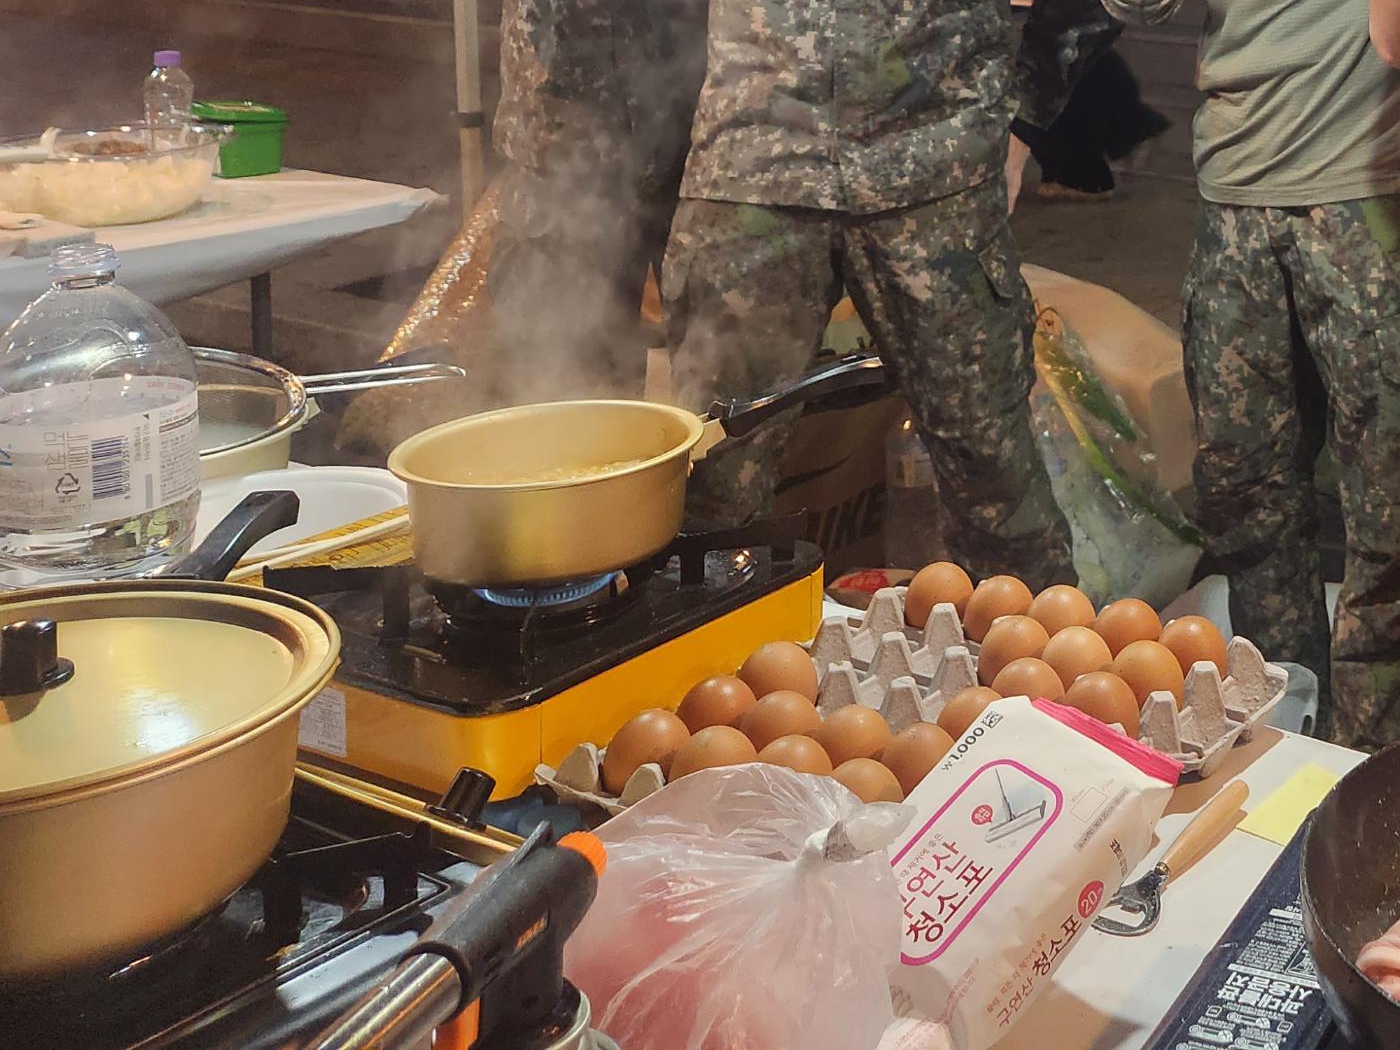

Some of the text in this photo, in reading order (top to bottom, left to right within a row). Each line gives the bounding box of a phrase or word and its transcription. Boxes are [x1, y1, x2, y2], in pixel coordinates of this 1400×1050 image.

[905, 861, 994, 943] 청소포
[996, 914, 1082, 1027] 구연산 청소포
[1224, 972, 1313, 1001] 사용금지
[1217, 984, 1304, 1015] 과대불판
